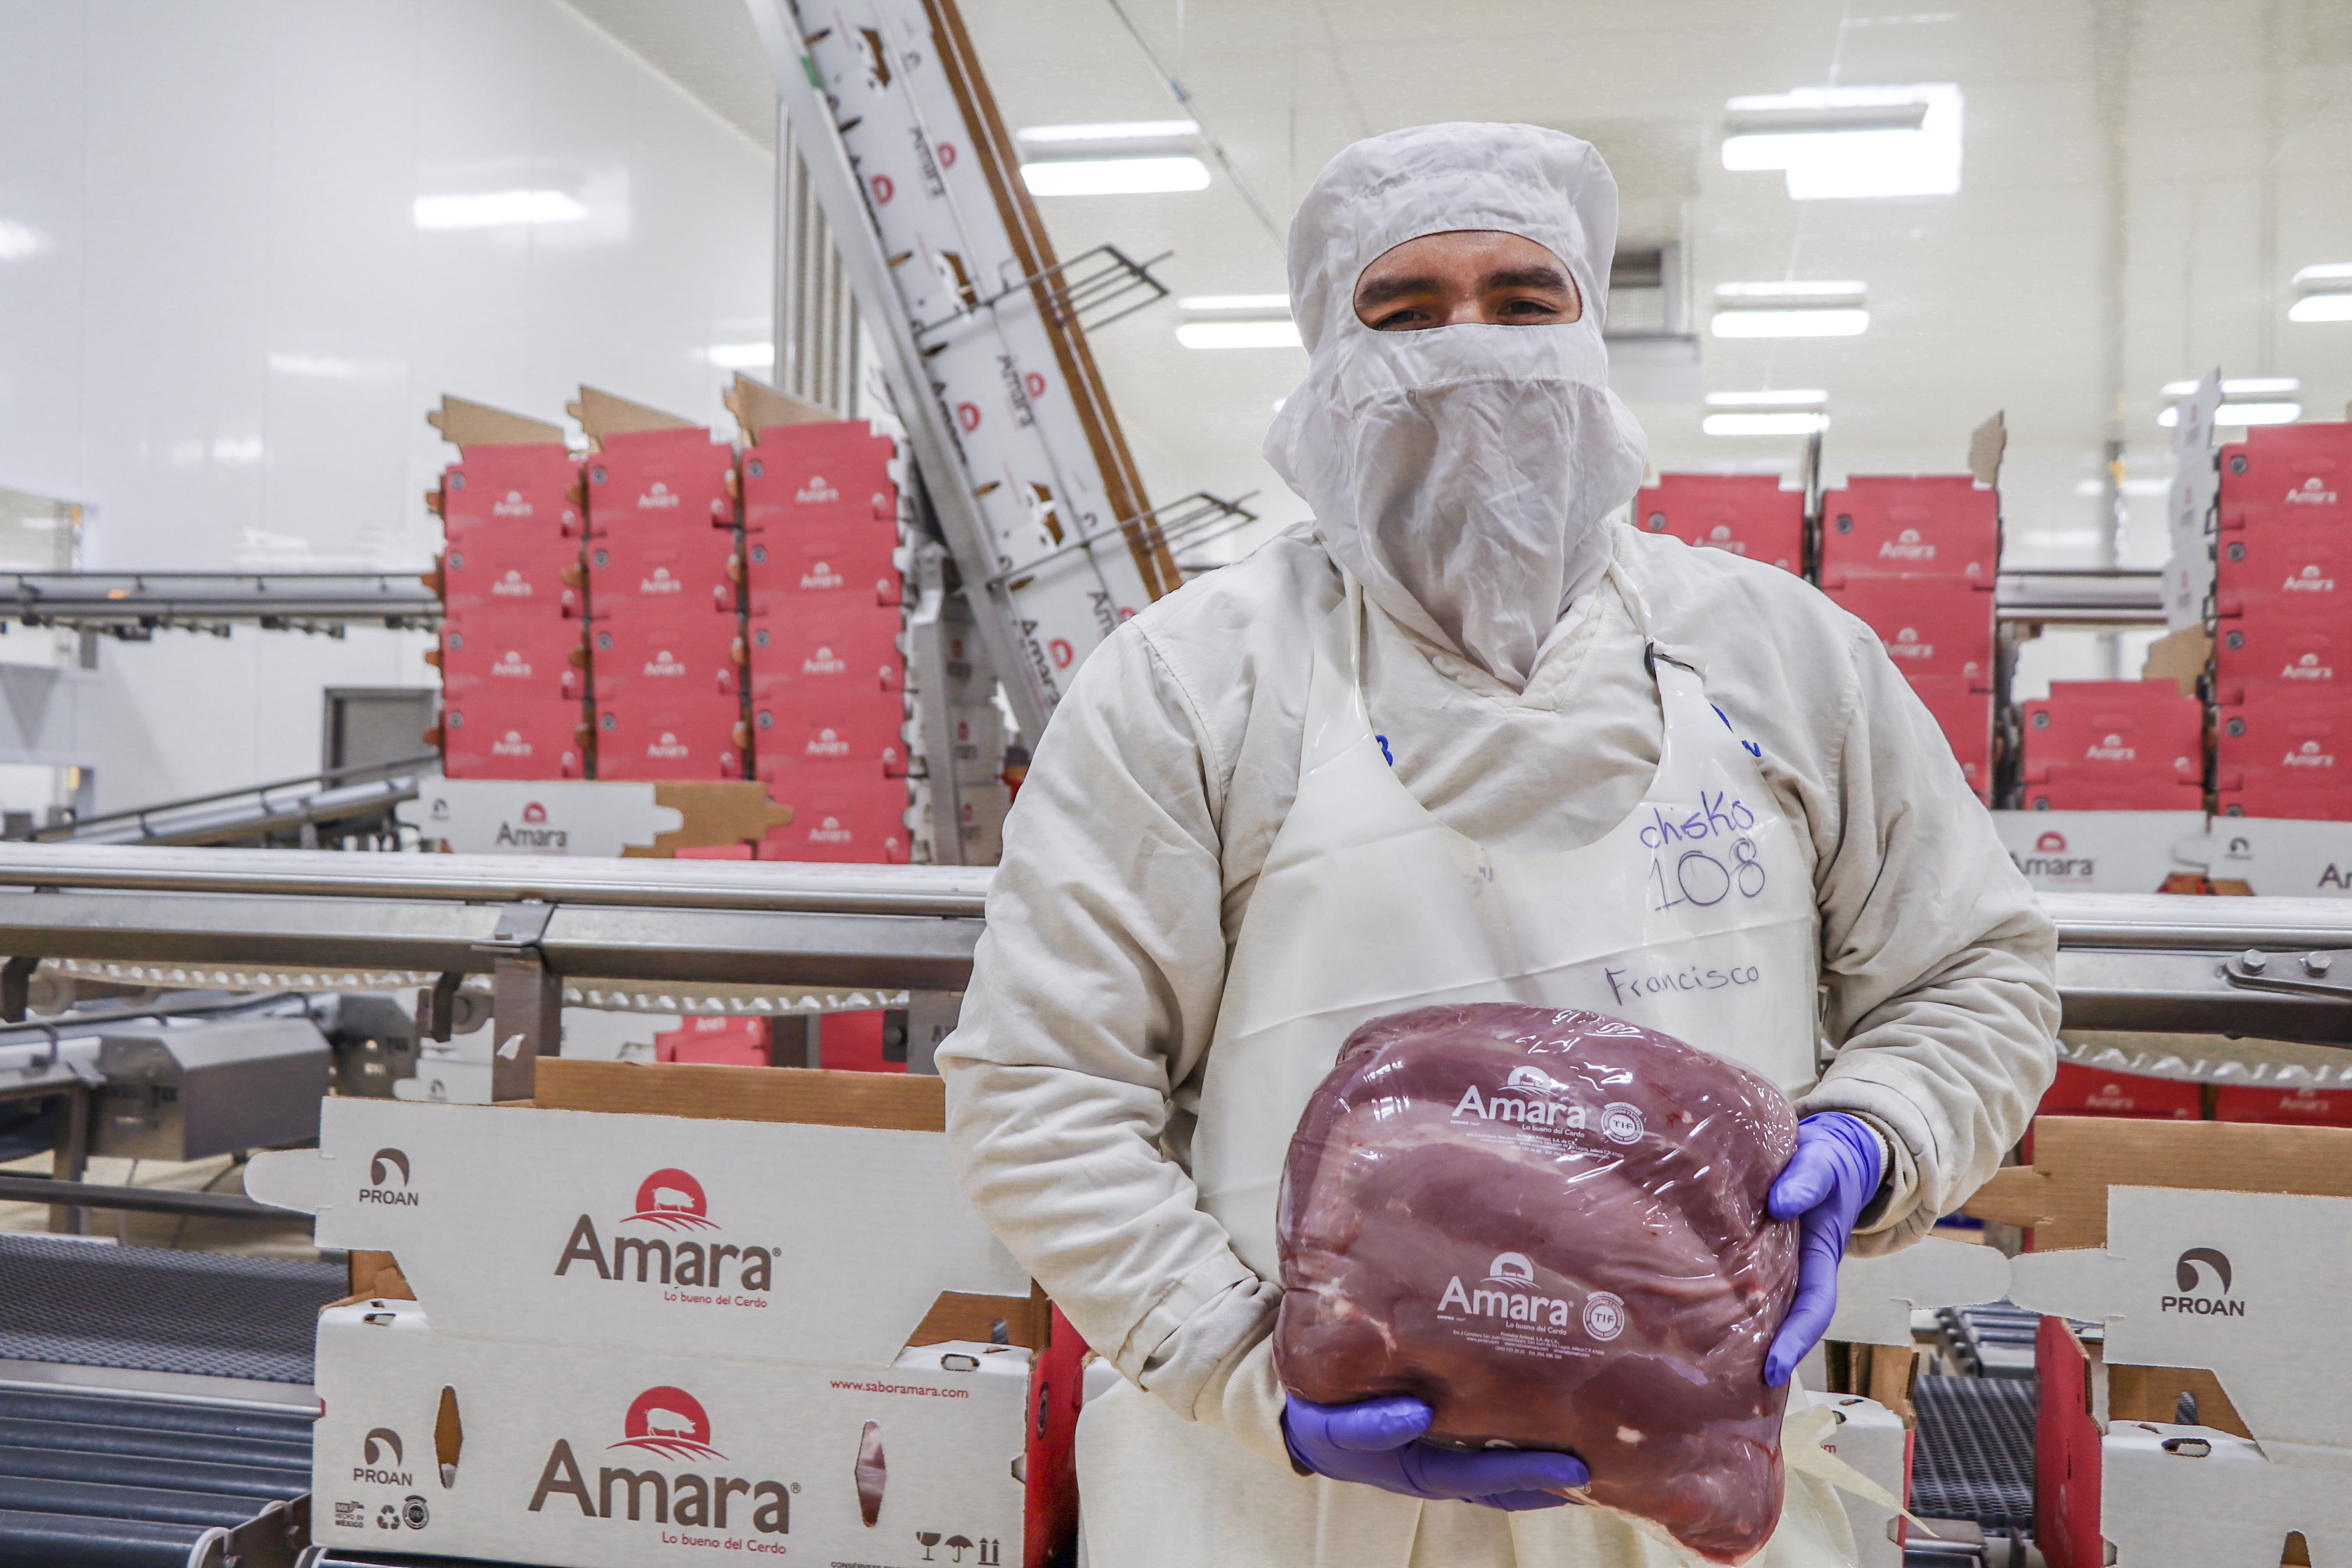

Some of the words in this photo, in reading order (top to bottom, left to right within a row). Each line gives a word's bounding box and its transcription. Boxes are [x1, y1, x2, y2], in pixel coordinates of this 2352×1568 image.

[496, 821, 568, 848] Amara
[1649, 837, 1765, 911] 108
[1605, 965, 1759, 1006] Francisco
[1564, 1129, 1585, 1138] Cerdo
[1613, 1120, 1633, 1129] TIF
[359, 1189, 419, 1206] PROAN
[664, 1291, 677, 1302] Lo
[681, 1292, 713, 1304] bueno
[716, 1295, 731, 1305] del
[734, 1296, 767, 1308] Cerdo
[2162, 1296, 2245, 1317] PROAN
[1595, 1312, 1614, 1323] TIF
[1516, 1322, 1535, 1331] bueno
[1547, 1327, 1567, 1335] Cerdo
[829, 1380, 969, 1399] www.saboramara.com
[353, 1468, 413, 1486] PROAN
[662, 1531, 678, 1544] Lo
[681, 1533, 720, 1548] bueno
[724, 1537, 742, 1550] del
[747, 1538, 786, 1554] Cerdo
